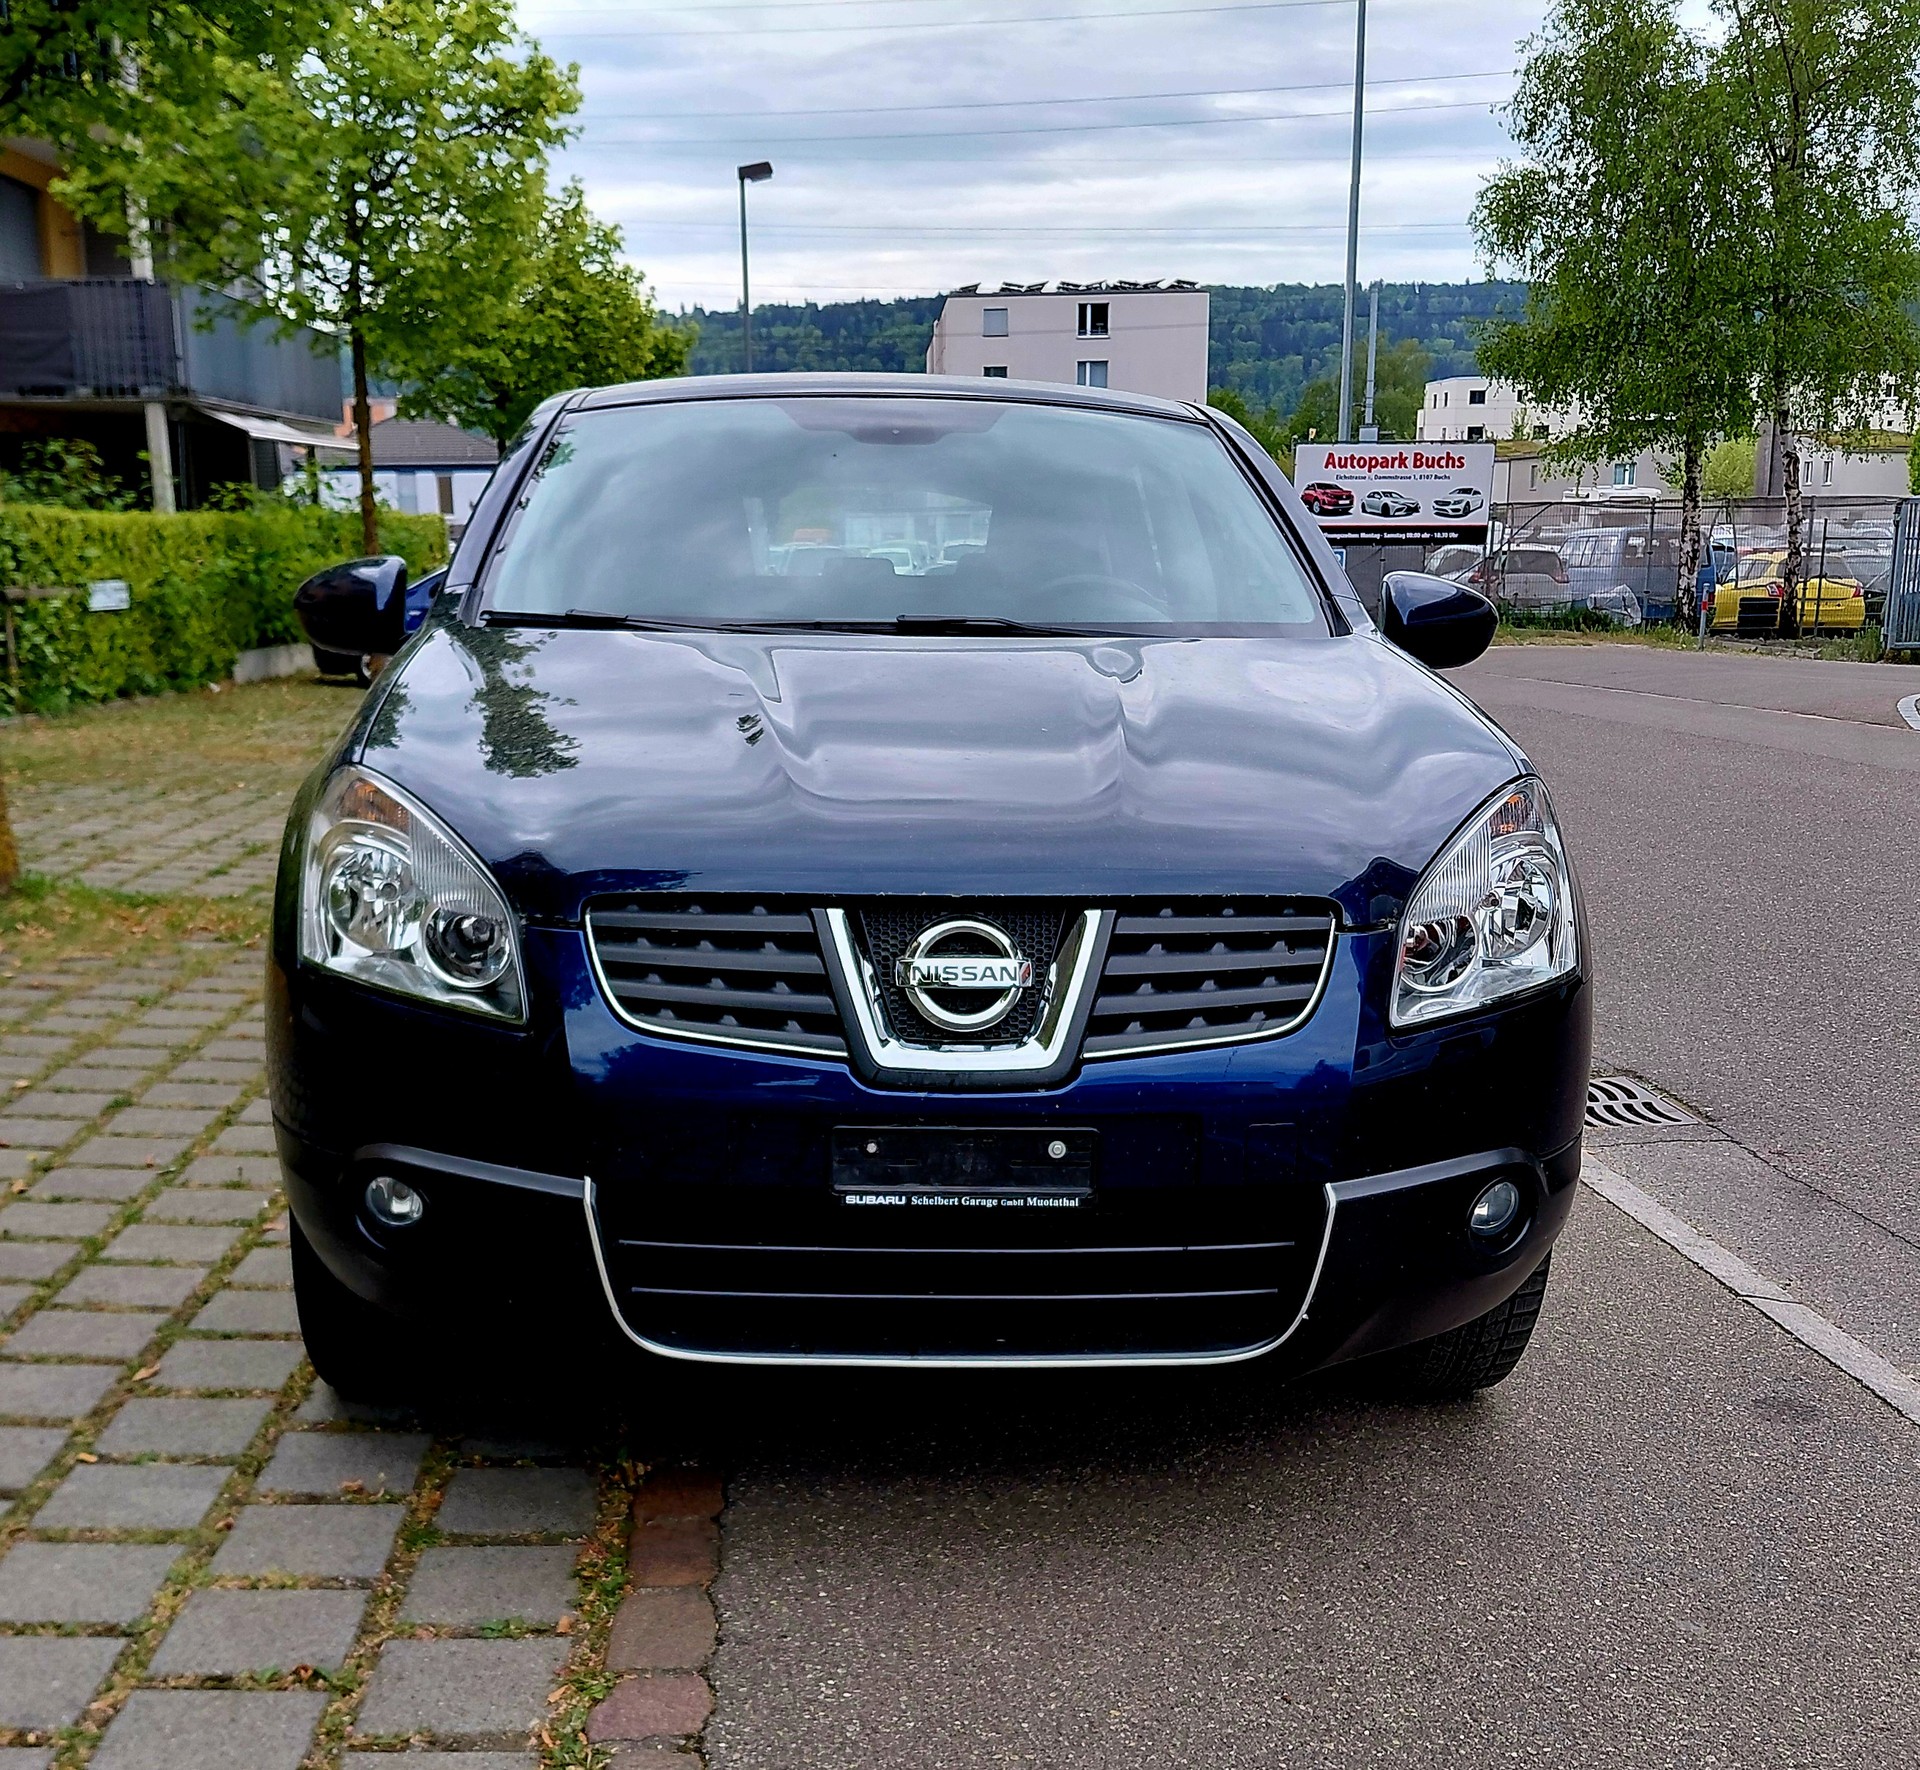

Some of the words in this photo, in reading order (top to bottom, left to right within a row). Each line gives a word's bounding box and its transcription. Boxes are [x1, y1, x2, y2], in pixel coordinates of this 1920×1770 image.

[1324, 451, 1408, 473] Autopark
[1412, 453, 1466, 469] Buchs
[911, 966, 1018, 982] NISSAN
[845, 1195, 906, 1205] SUBARU
[911, 1196, 959, 1206] Schelbert
[961, 1197, 998, 1207] Garage
[1026, 1197, 1079, 1207] Muotathal
